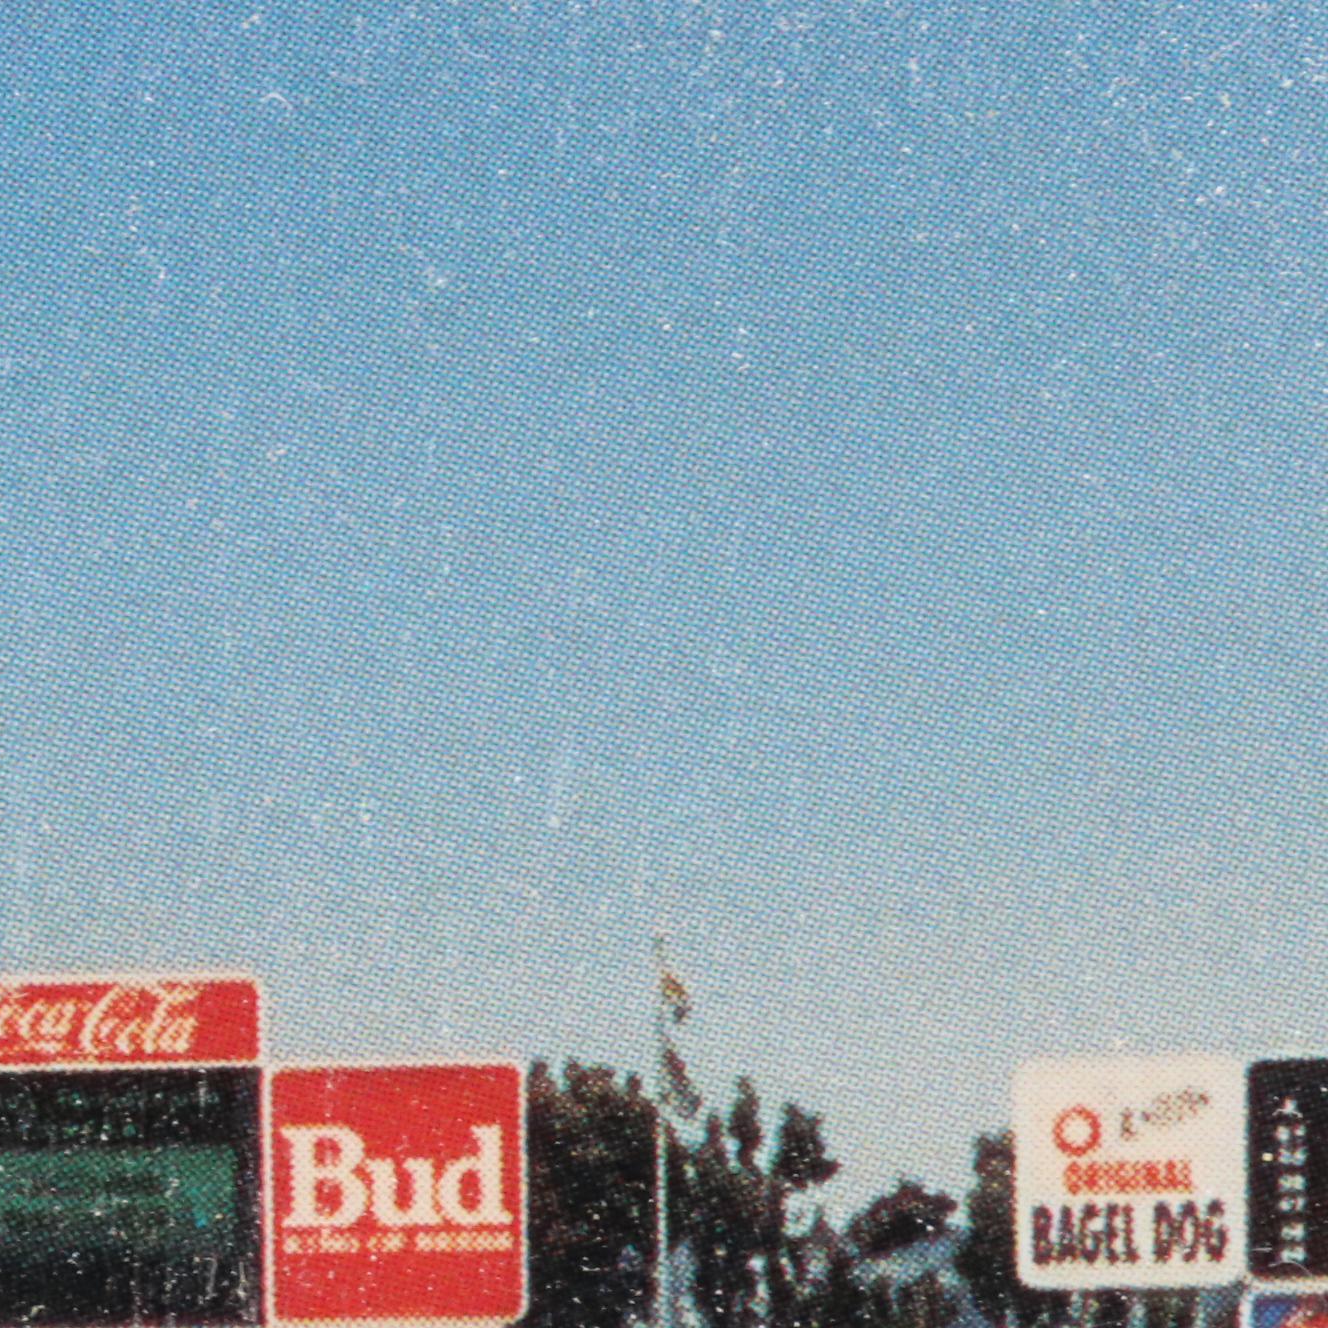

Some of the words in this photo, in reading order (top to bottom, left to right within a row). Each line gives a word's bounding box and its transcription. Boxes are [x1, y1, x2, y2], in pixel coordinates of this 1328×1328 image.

[280, 1123, 515, 1229] Bud
[1031, 1202, 1140, 1266] BAGEL
[1152, 1198, 1230, 1264] DOG
